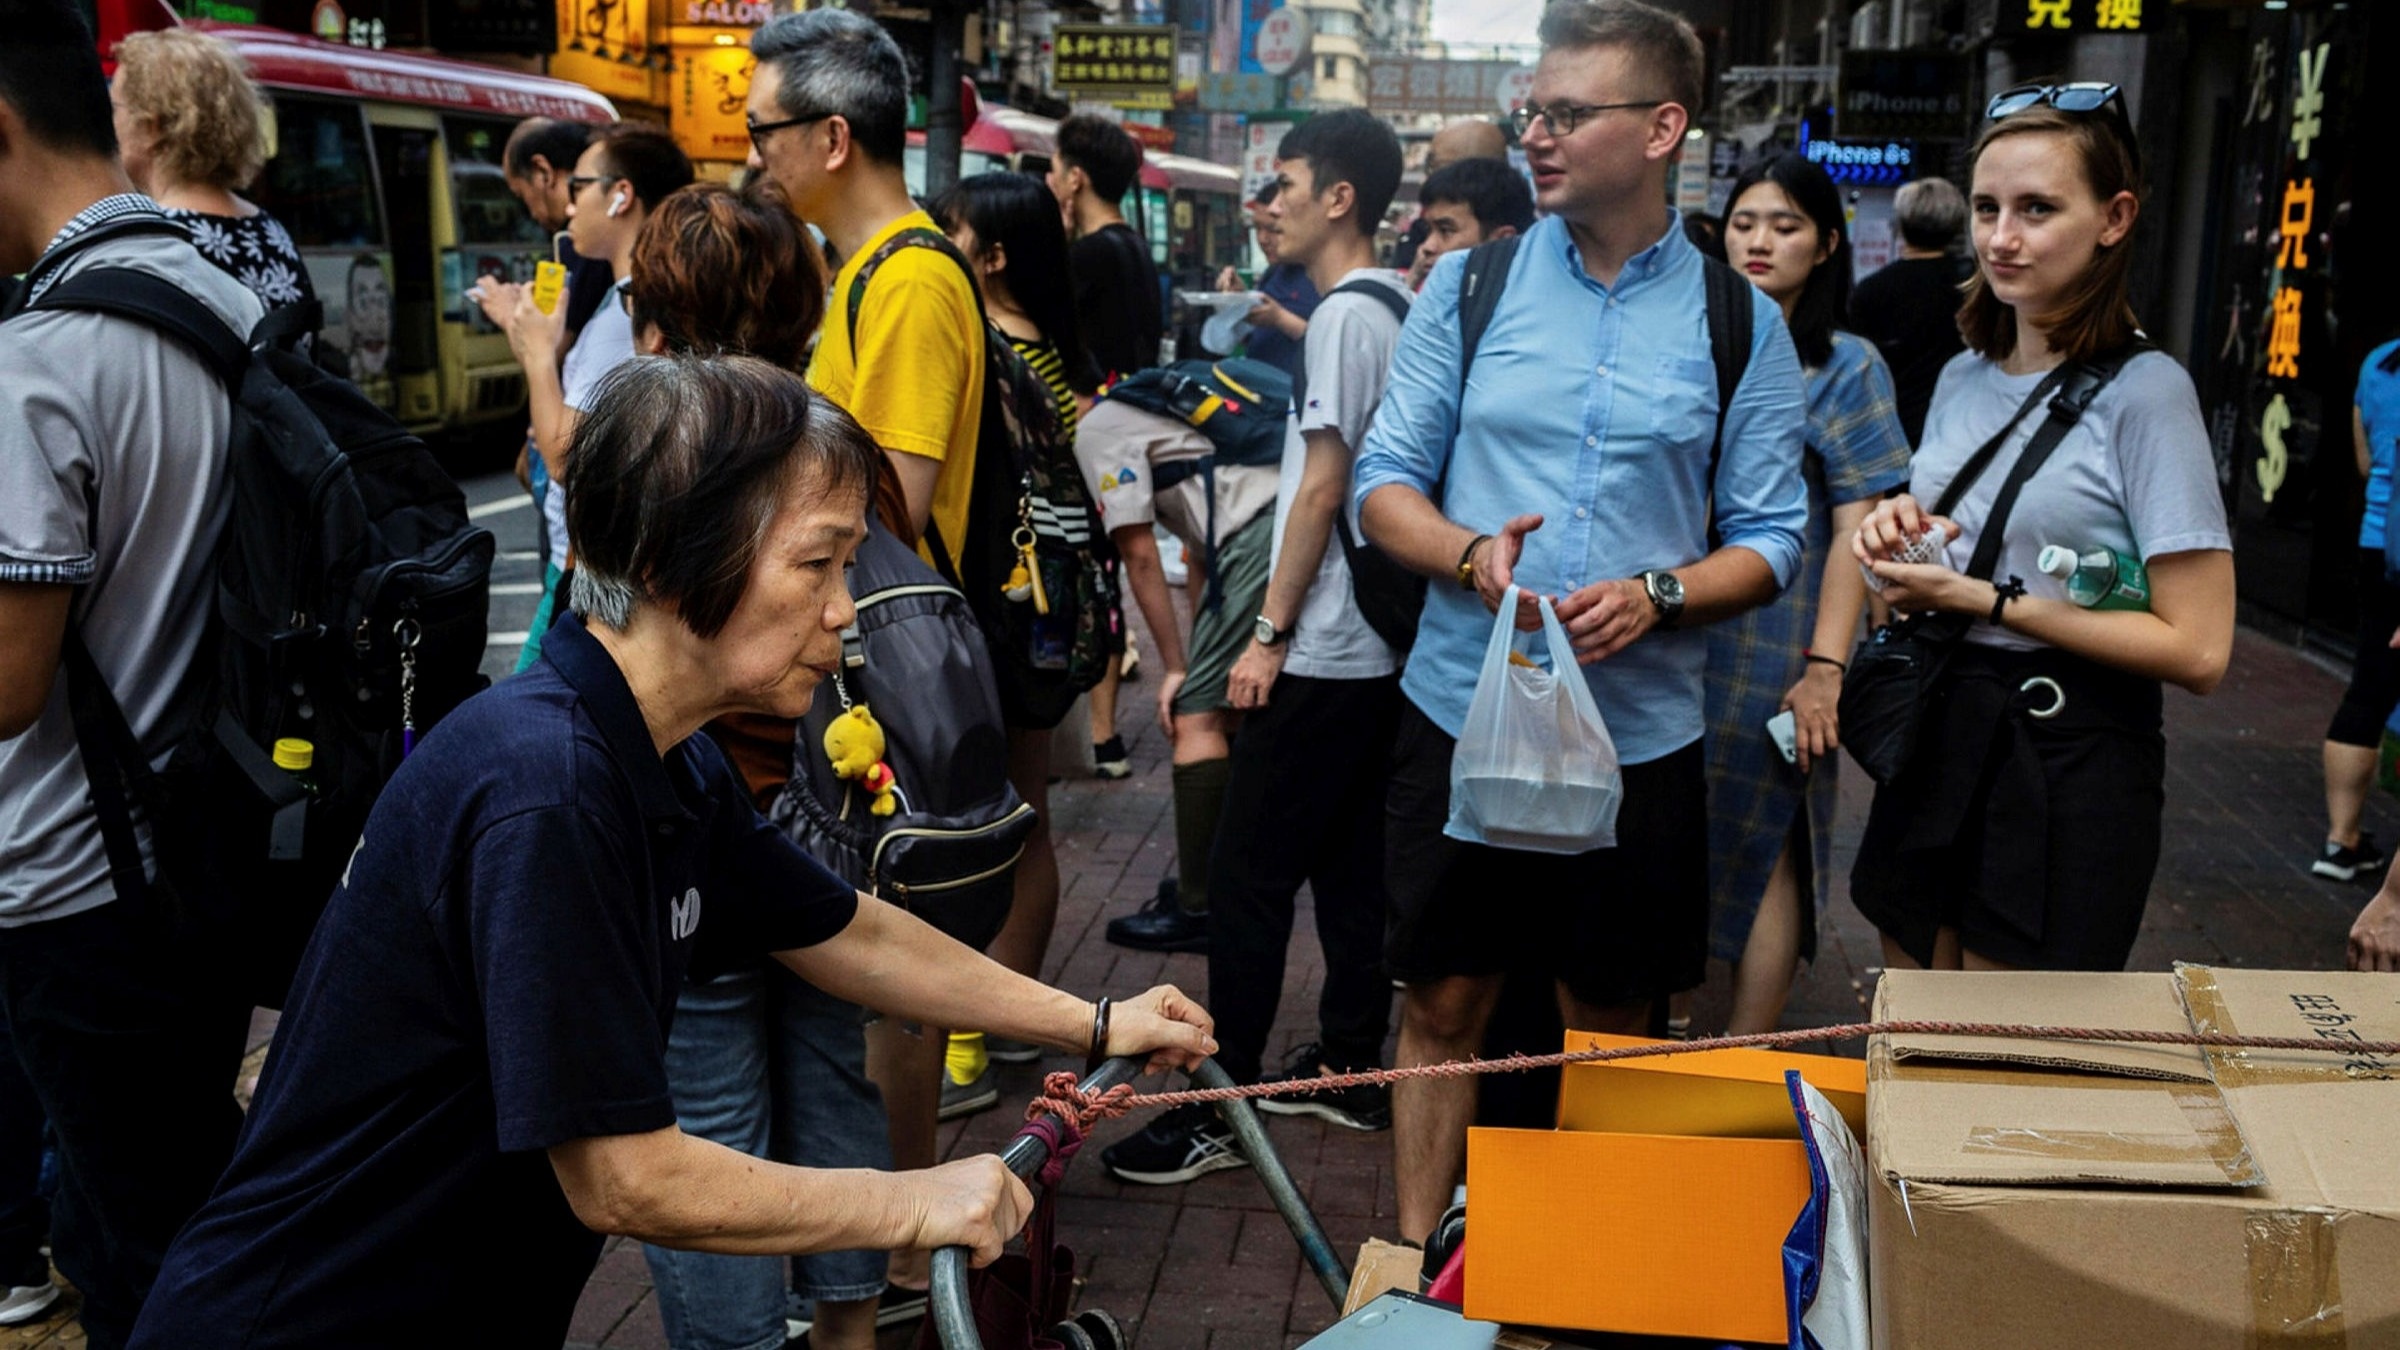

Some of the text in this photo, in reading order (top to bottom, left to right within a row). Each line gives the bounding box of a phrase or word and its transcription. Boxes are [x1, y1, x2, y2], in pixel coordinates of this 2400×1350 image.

[686, 3, 774, 24] SALON
[1850, 90, 1939, 113] iPhone
[1807, 140, 1882, 164] iPhone
